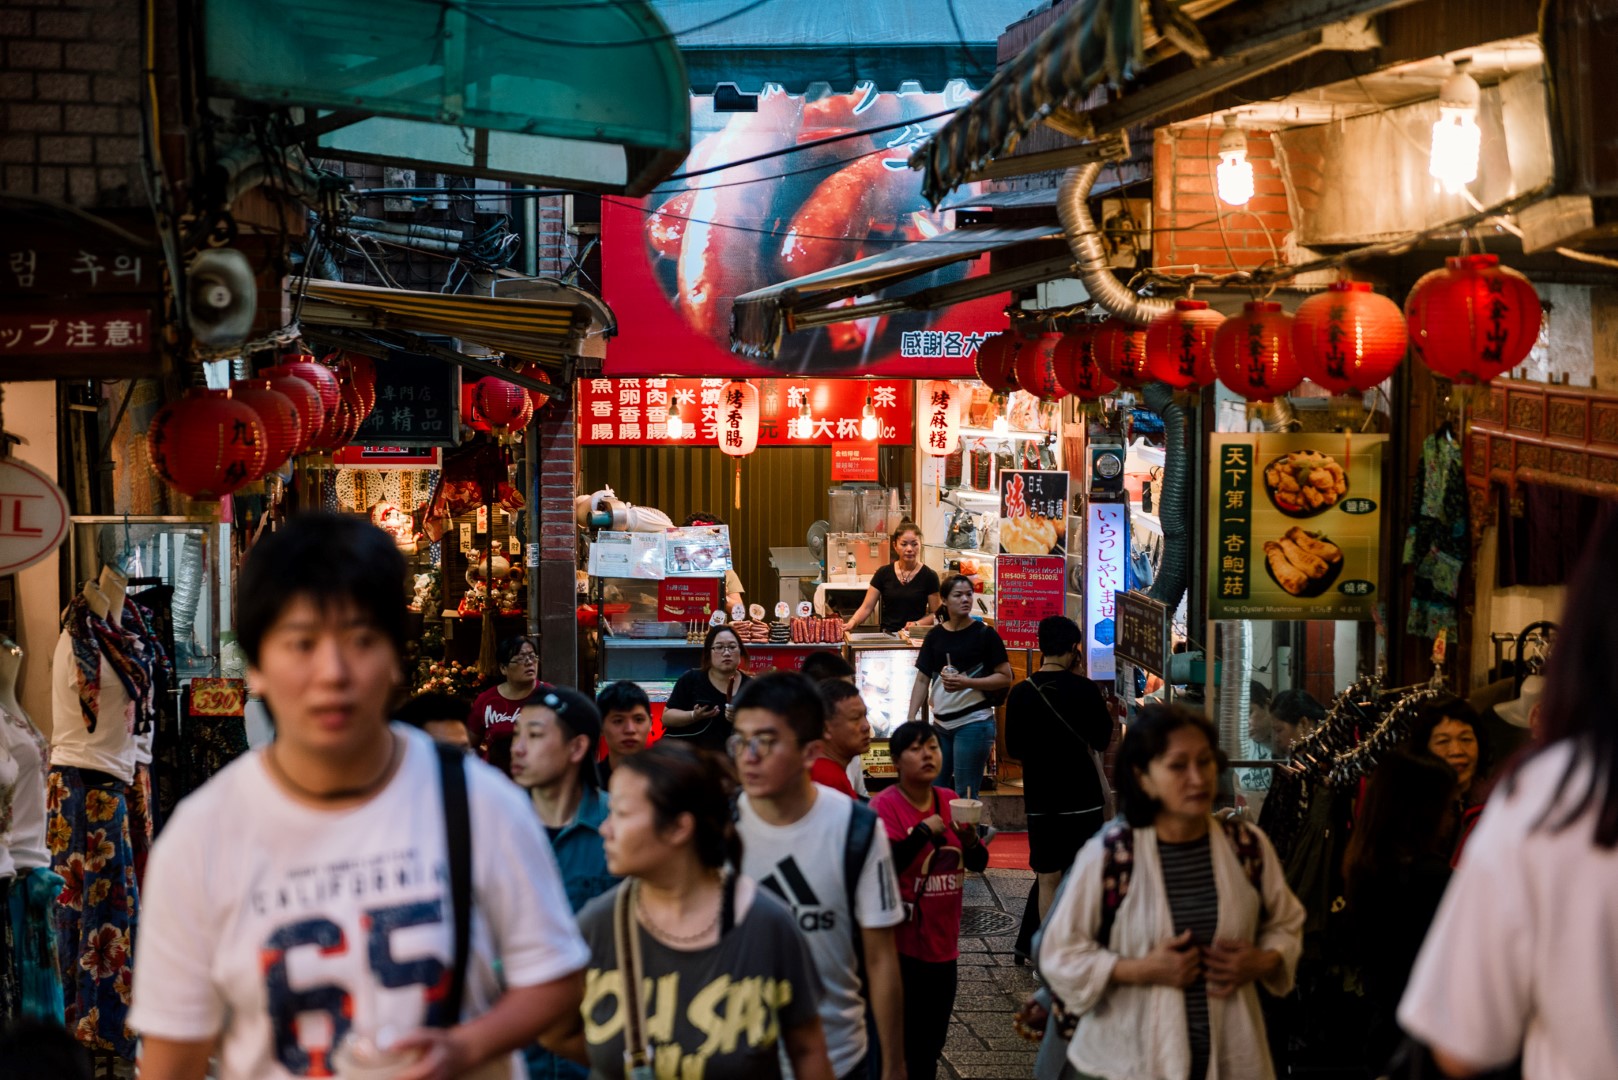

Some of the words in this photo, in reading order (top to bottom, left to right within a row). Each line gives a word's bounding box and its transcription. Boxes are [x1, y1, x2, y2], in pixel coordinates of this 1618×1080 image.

[70, 250, 142, 287] 주의
[901, 331, 1003, 358] 感謝各大
[726, 389, 744, 448] 烤香腸
[1029, 475, 1044, 494] 日式
[1222, 447, 1247, 595] 天下第一杏鮑菇
[1223, 605, 1240, 614] King
[1241, 605, 1264, 613] Oyster
[1265, 605, 1302, 613] Mushroom
